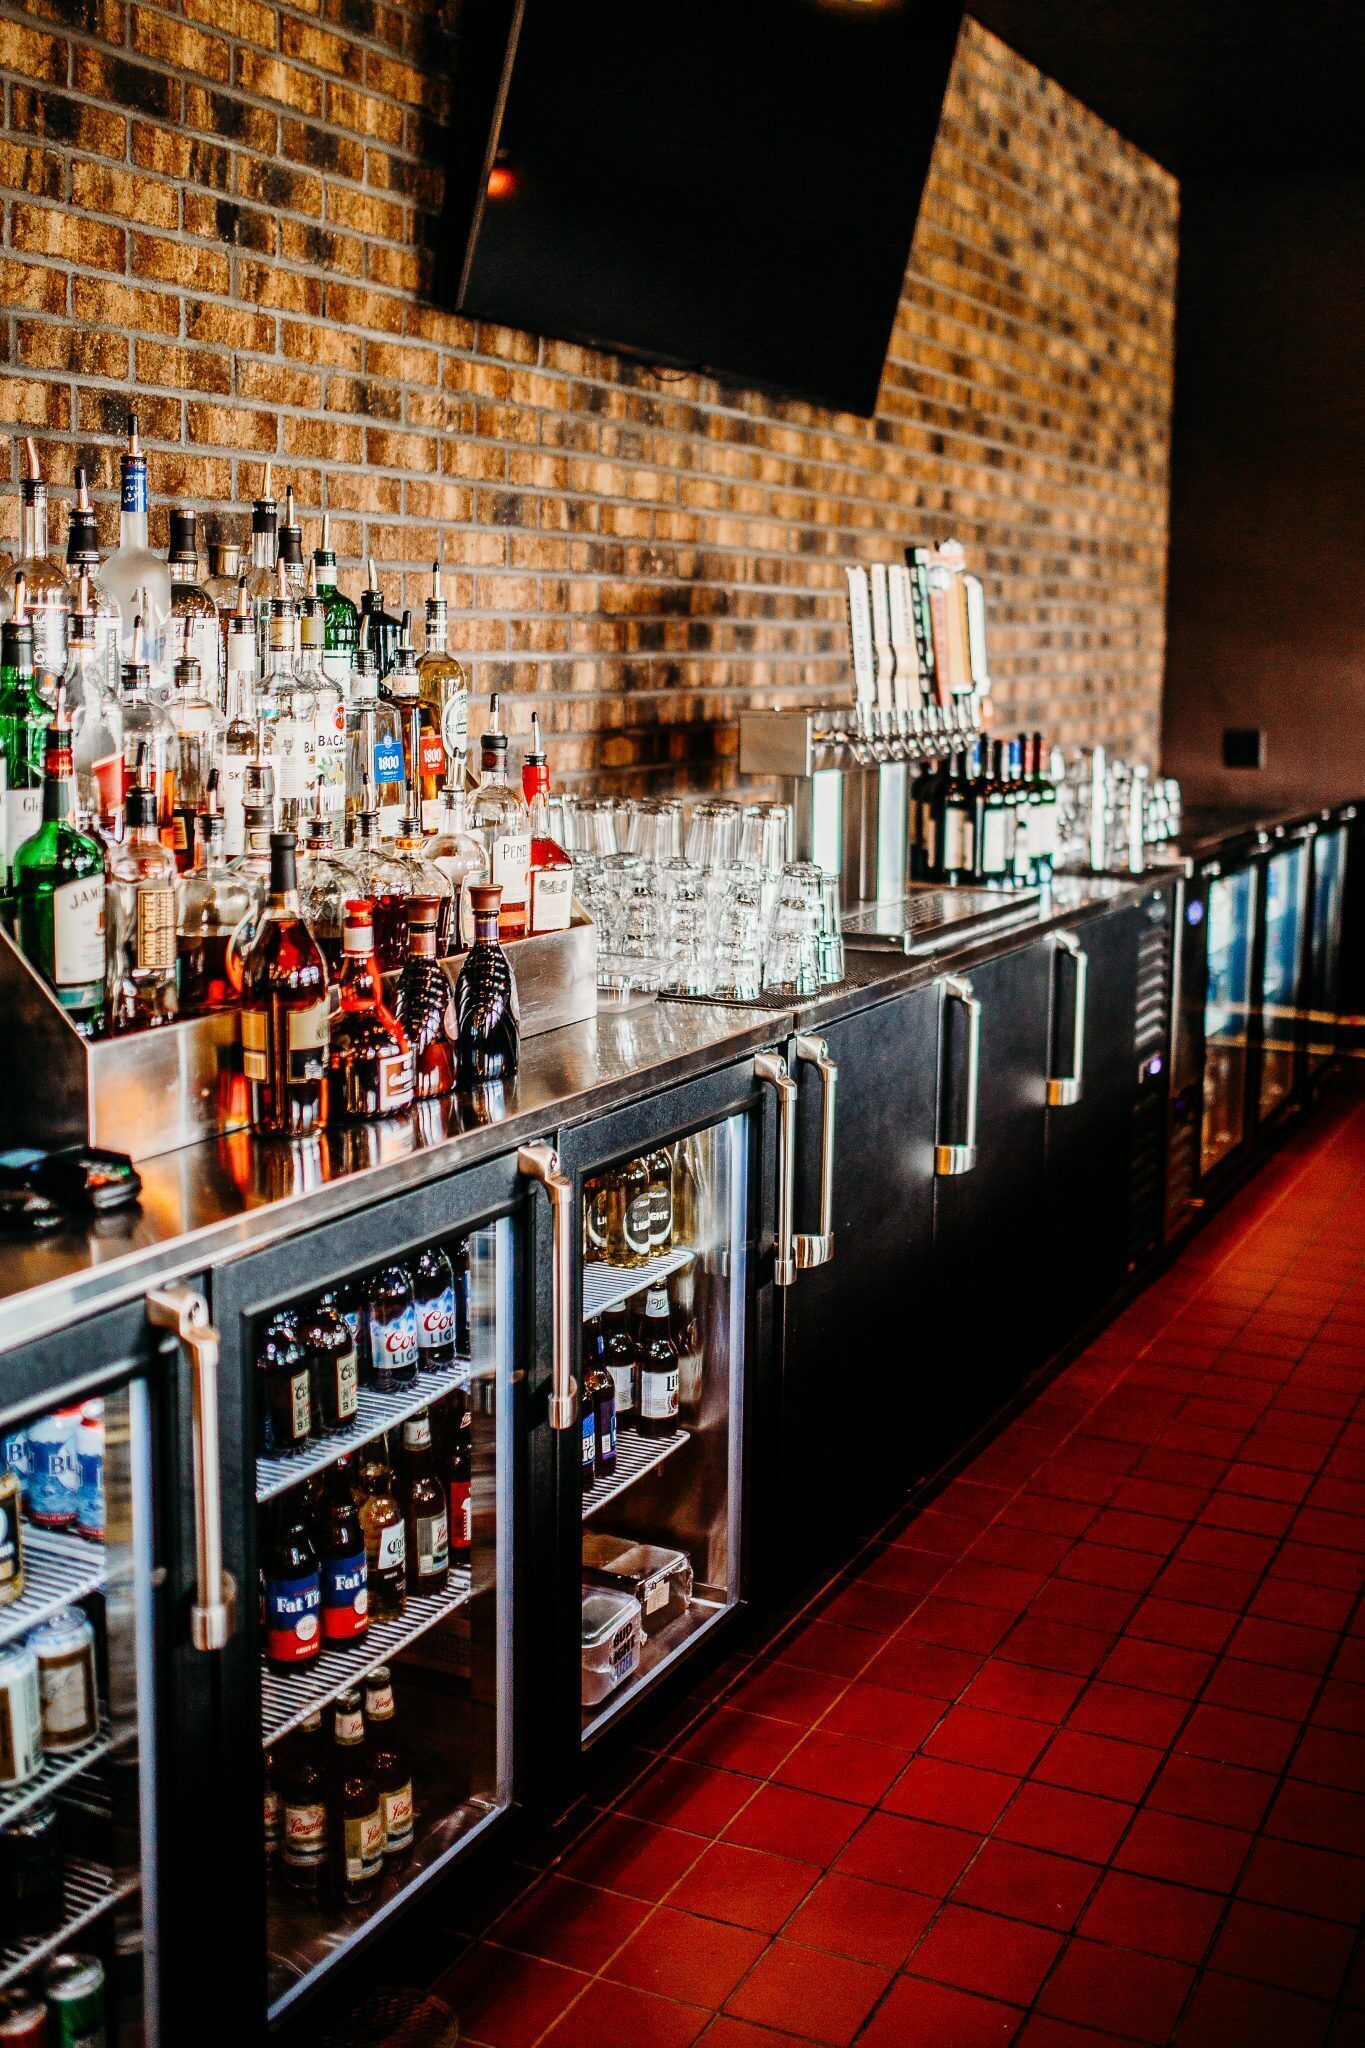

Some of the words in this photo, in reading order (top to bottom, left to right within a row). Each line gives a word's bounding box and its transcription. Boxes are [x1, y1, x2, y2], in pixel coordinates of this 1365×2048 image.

[318, 735, 346, 747] BACA
[378, 755, 400, 770] 1800
[424, 747, 442, 763] 1800
[430, 1327, 456, 1345] LIG
[335, 1572, 360, 1590] Fat
[277, 1597, 303, 1612] Fat
